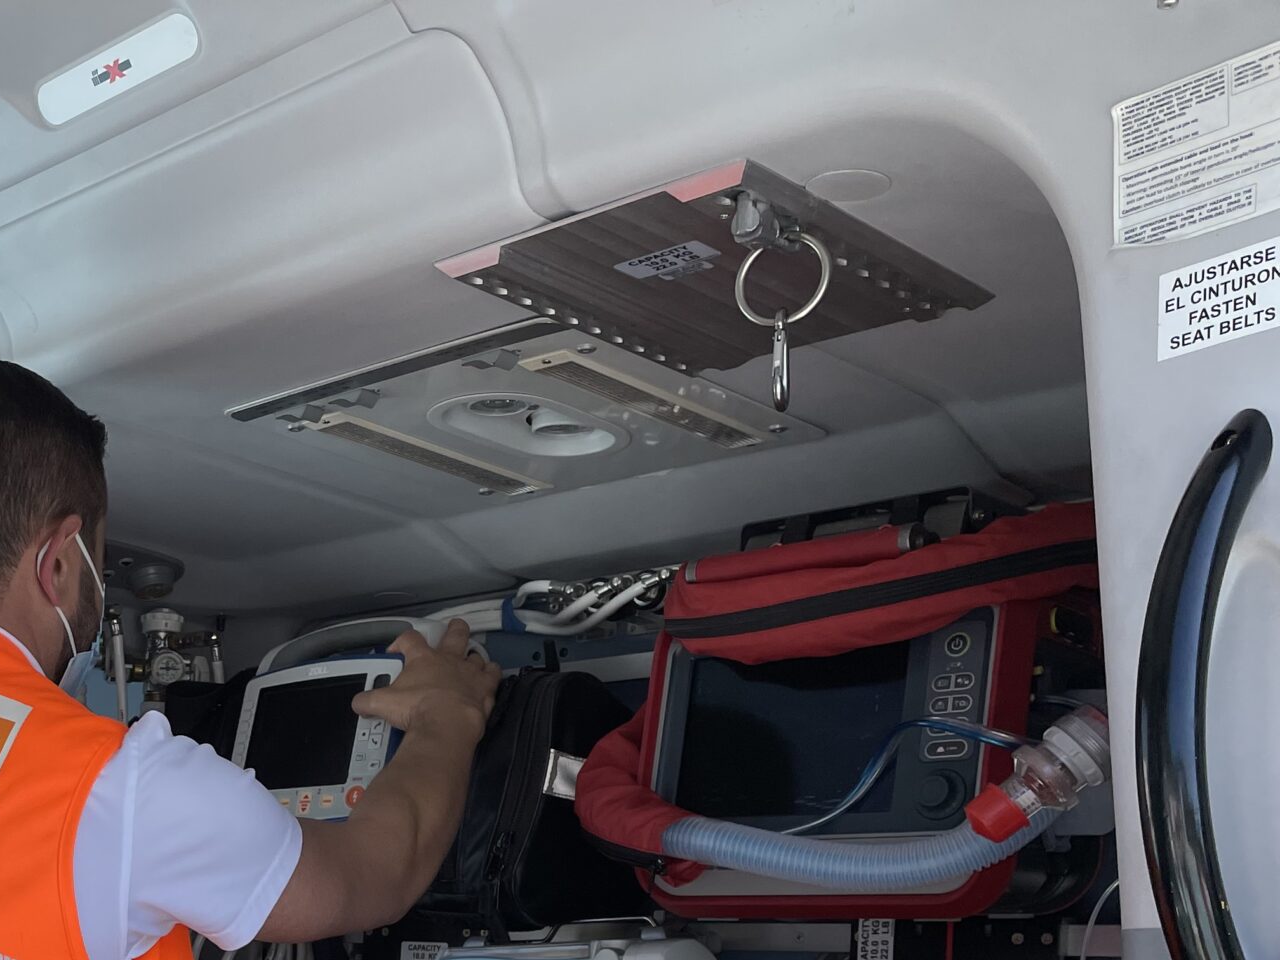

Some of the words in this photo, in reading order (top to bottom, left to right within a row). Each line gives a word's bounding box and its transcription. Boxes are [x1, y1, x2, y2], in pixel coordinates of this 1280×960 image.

[628, 245, 688, 267] CAPACITY
[1172, 246, 1276, 292] AJUSTARSE
[1165, 296, 1186, 314] EL
[1190, 266, 1280, 305] CINTURON
[1189, 292, 1257, 326] FASTEN
[1170, 325, 1215, 350] SEAT
[1219, 306, 1276, 336] BELTS
[872, 920, 880, 935] KG
[882, 920, 890, 934] LB
[408, 944, 441, 952] CAPACITY
[870, 940, 879, 960] 10.0
[880, 940, 889, 960] 22.0
